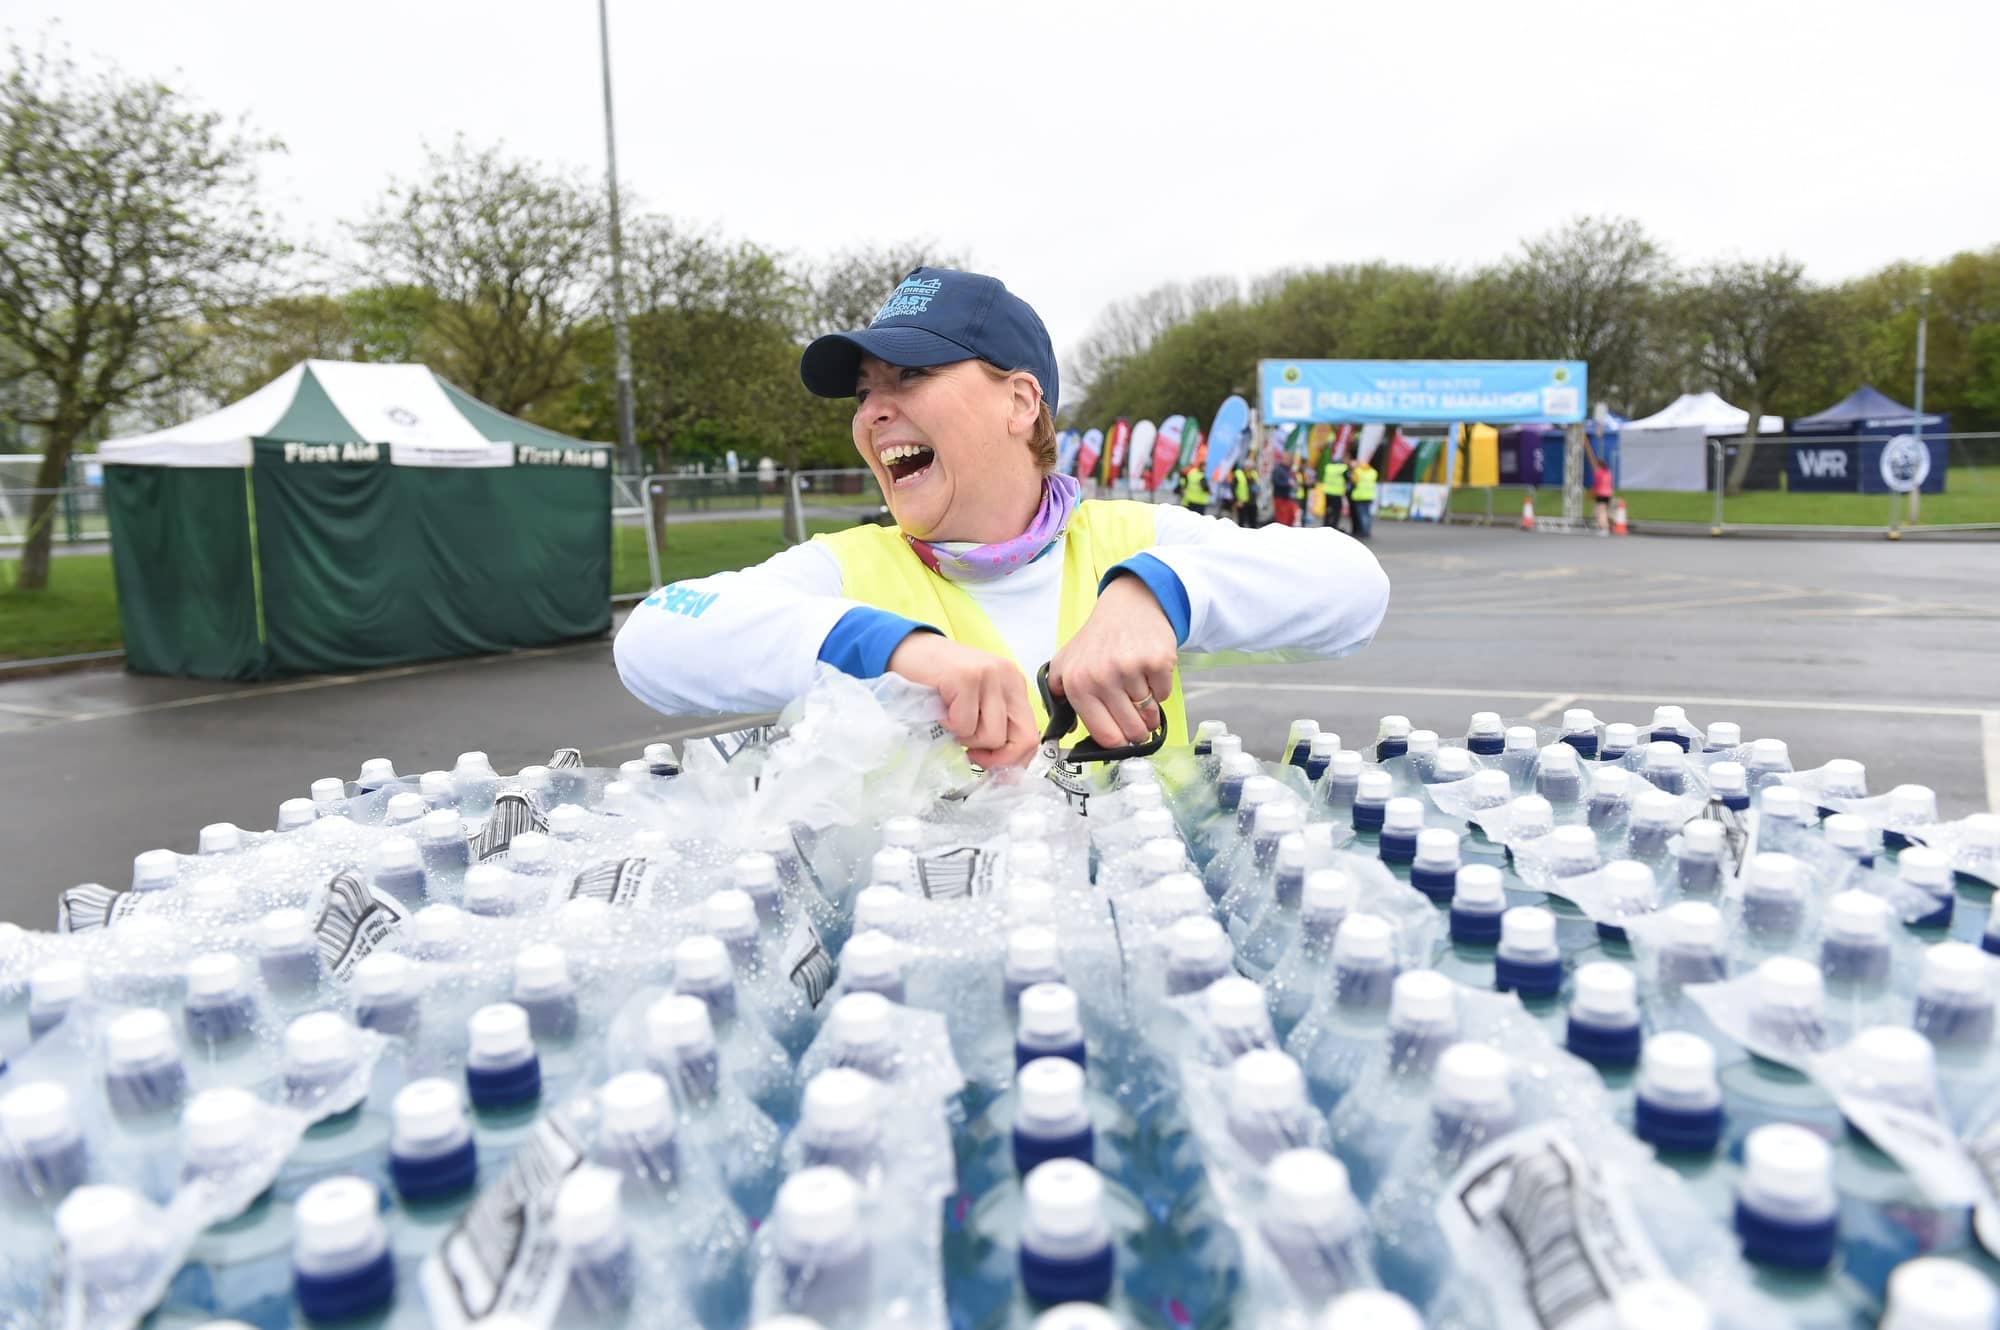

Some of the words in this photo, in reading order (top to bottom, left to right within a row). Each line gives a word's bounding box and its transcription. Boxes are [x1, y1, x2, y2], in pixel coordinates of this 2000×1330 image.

[903, 287, 939, 295] DIRECT
[1316, 391, 1395, 409] BELFAST
[1398, 392, 1438, 409] CITY
[1441, 391, 1540, 408] MARATHON
[284, 442, 338, 463] First
[342, 442, 379, 462] Aid
[518, 445, 561, 465] First
[562, 448, 591, 468] Aid
[1796, 449, 1848, 478] WFR
